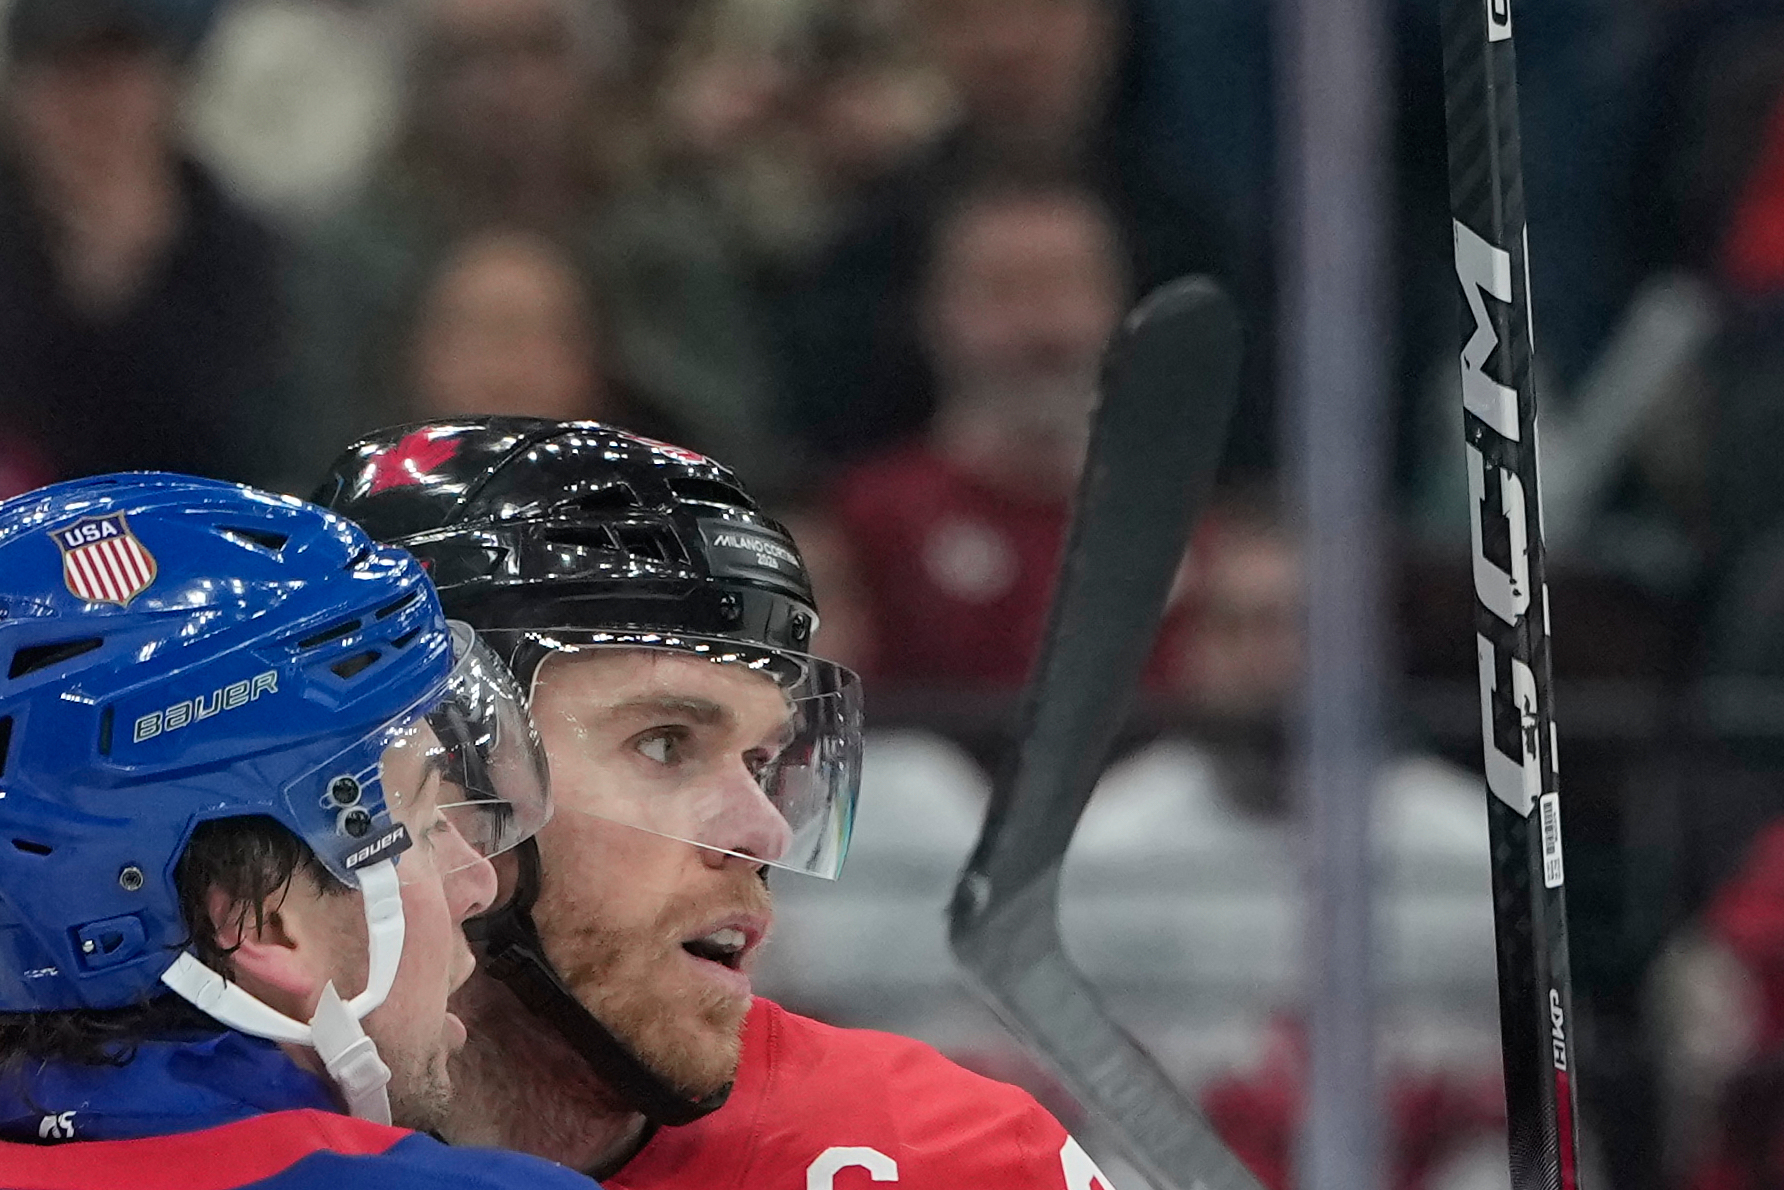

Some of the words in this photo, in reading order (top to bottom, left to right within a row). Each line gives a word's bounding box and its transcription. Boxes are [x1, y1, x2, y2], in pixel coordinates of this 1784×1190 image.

[64, 522, 118, 548] USA
[1453, 217, 1542, 819] CCM
[714, 534, 763, 552] MILANO
[134, 670, 279, 744] BAUER
[345, 827, 405, 869] BAUER
